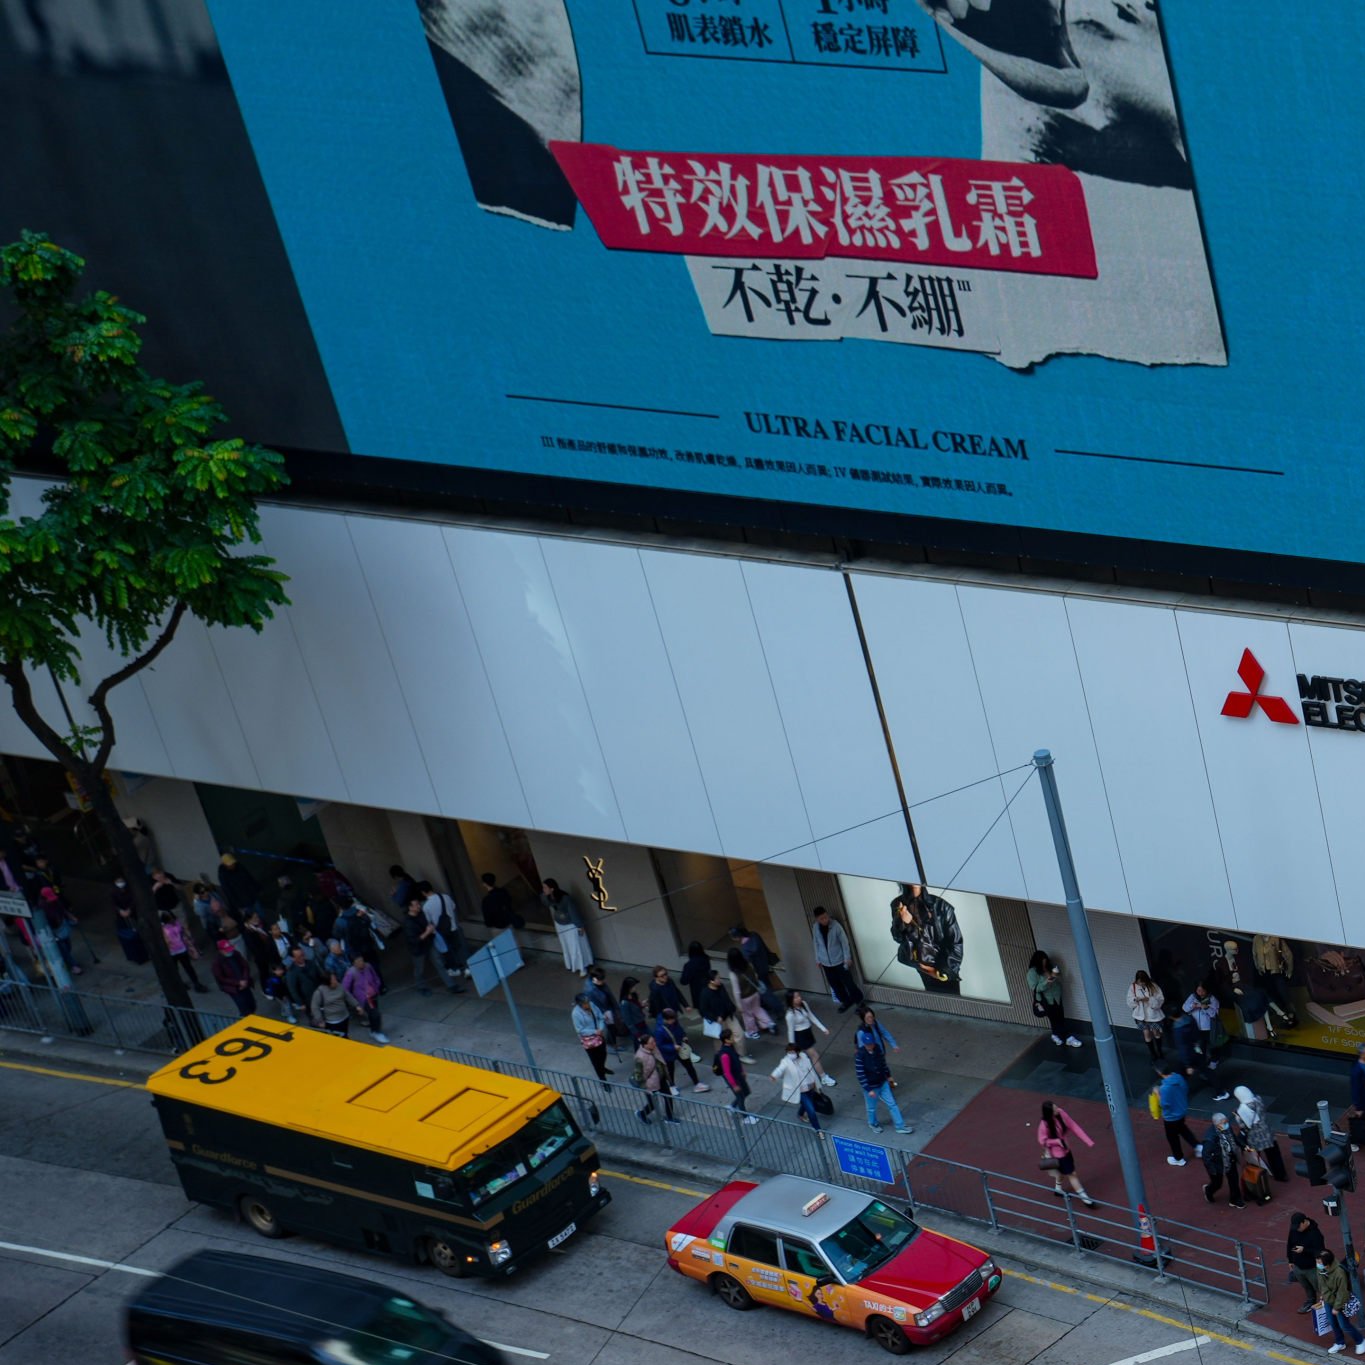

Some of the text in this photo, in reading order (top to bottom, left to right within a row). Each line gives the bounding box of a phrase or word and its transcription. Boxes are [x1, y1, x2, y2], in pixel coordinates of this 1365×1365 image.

[666, 12, 773, 48] 肌表鎖水
[810, 21, 920, 59] 穩定屏障
[613, 156, 1043, 258] 特效保濕乳霜
[744, 411, 1029, 461] ULTRA FACIAL CREAM
[179, 1026, 295, 1085] 163
[512, 1166, 575, 1215] Guardforce
